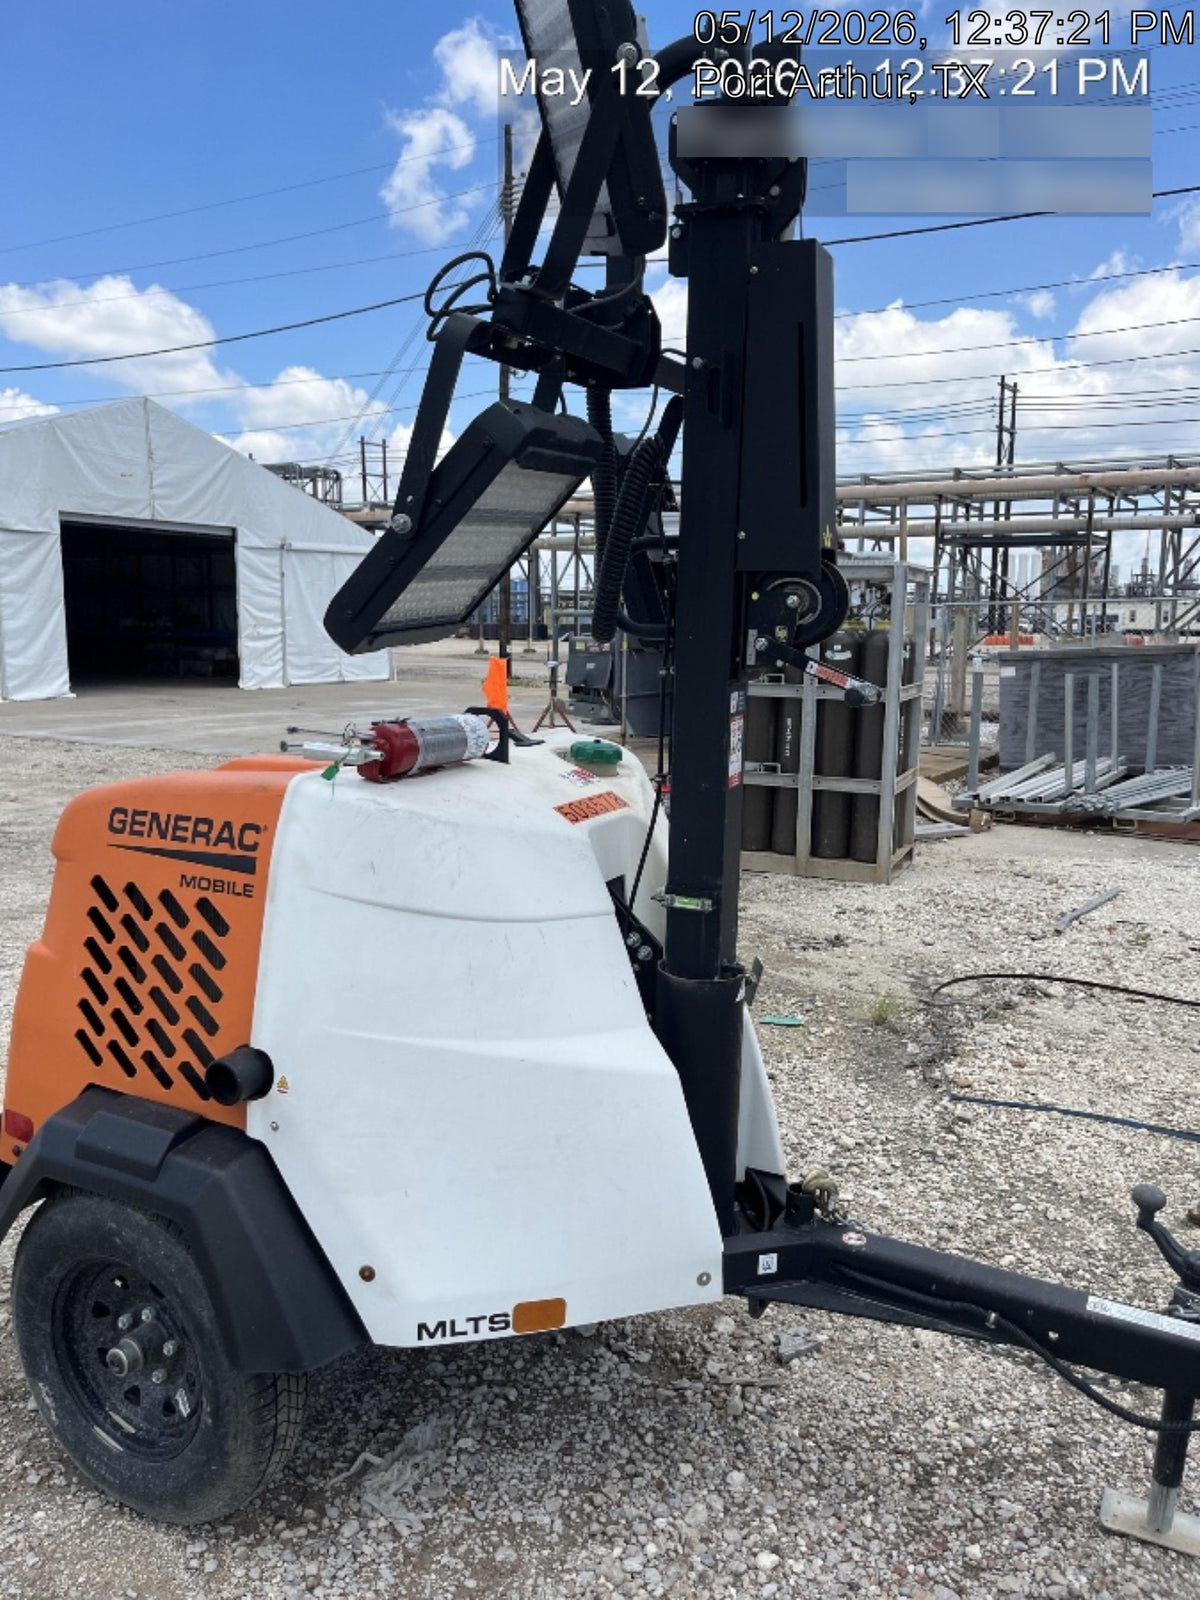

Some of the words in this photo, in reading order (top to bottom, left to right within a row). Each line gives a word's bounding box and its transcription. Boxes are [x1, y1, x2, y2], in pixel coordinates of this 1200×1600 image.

[108, 807, 261, 852] GENERAC
[179, 874, 254, 898] MOBILE
[417, 1312, 511, 1341] MLTS
